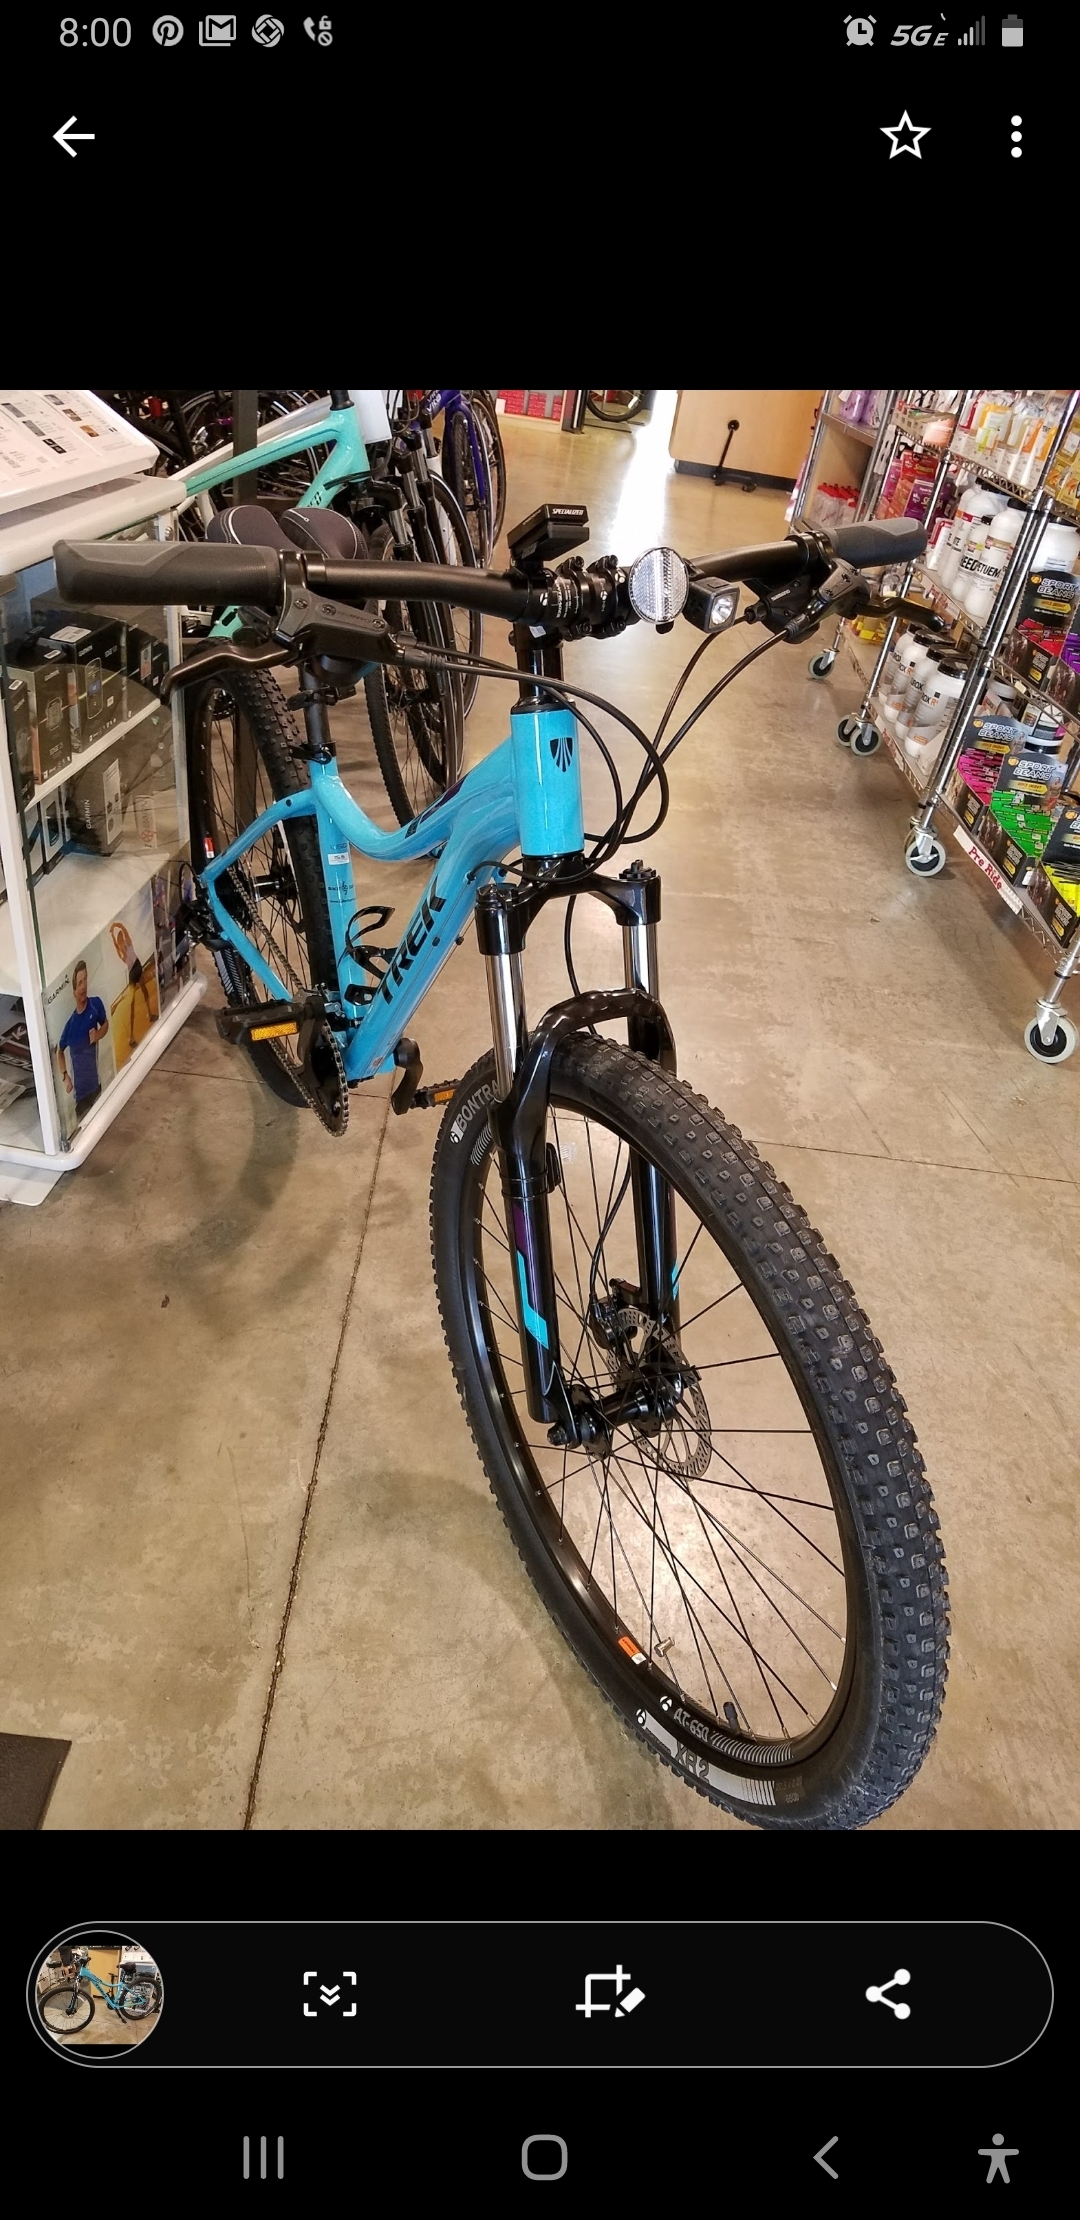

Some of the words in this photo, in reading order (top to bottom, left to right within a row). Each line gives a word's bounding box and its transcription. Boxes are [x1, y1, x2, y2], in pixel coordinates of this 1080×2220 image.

[552, 508, 584, 516] SPECIALIZED
[1041, 578, 1079, 591] SPORT
[1037, 585, 1075, 600] BEANS
[978, 728, 1014, 742] BEANS
[983, 722, 1019, 734] SPORT
[1013, 766, 1052, 781] BEANS
[1018, 760, 1056, 773] SPORT
[84, 799, 92, 829] GARMIN
[968, 846, 984, 866] Pre
[984, 863, 1002, 890] Ride
[376, 873, 447, 1005] TREK
[47, 978, 70, 1004] GARMIN
[673, 1707, 710, 1743] AT-650
